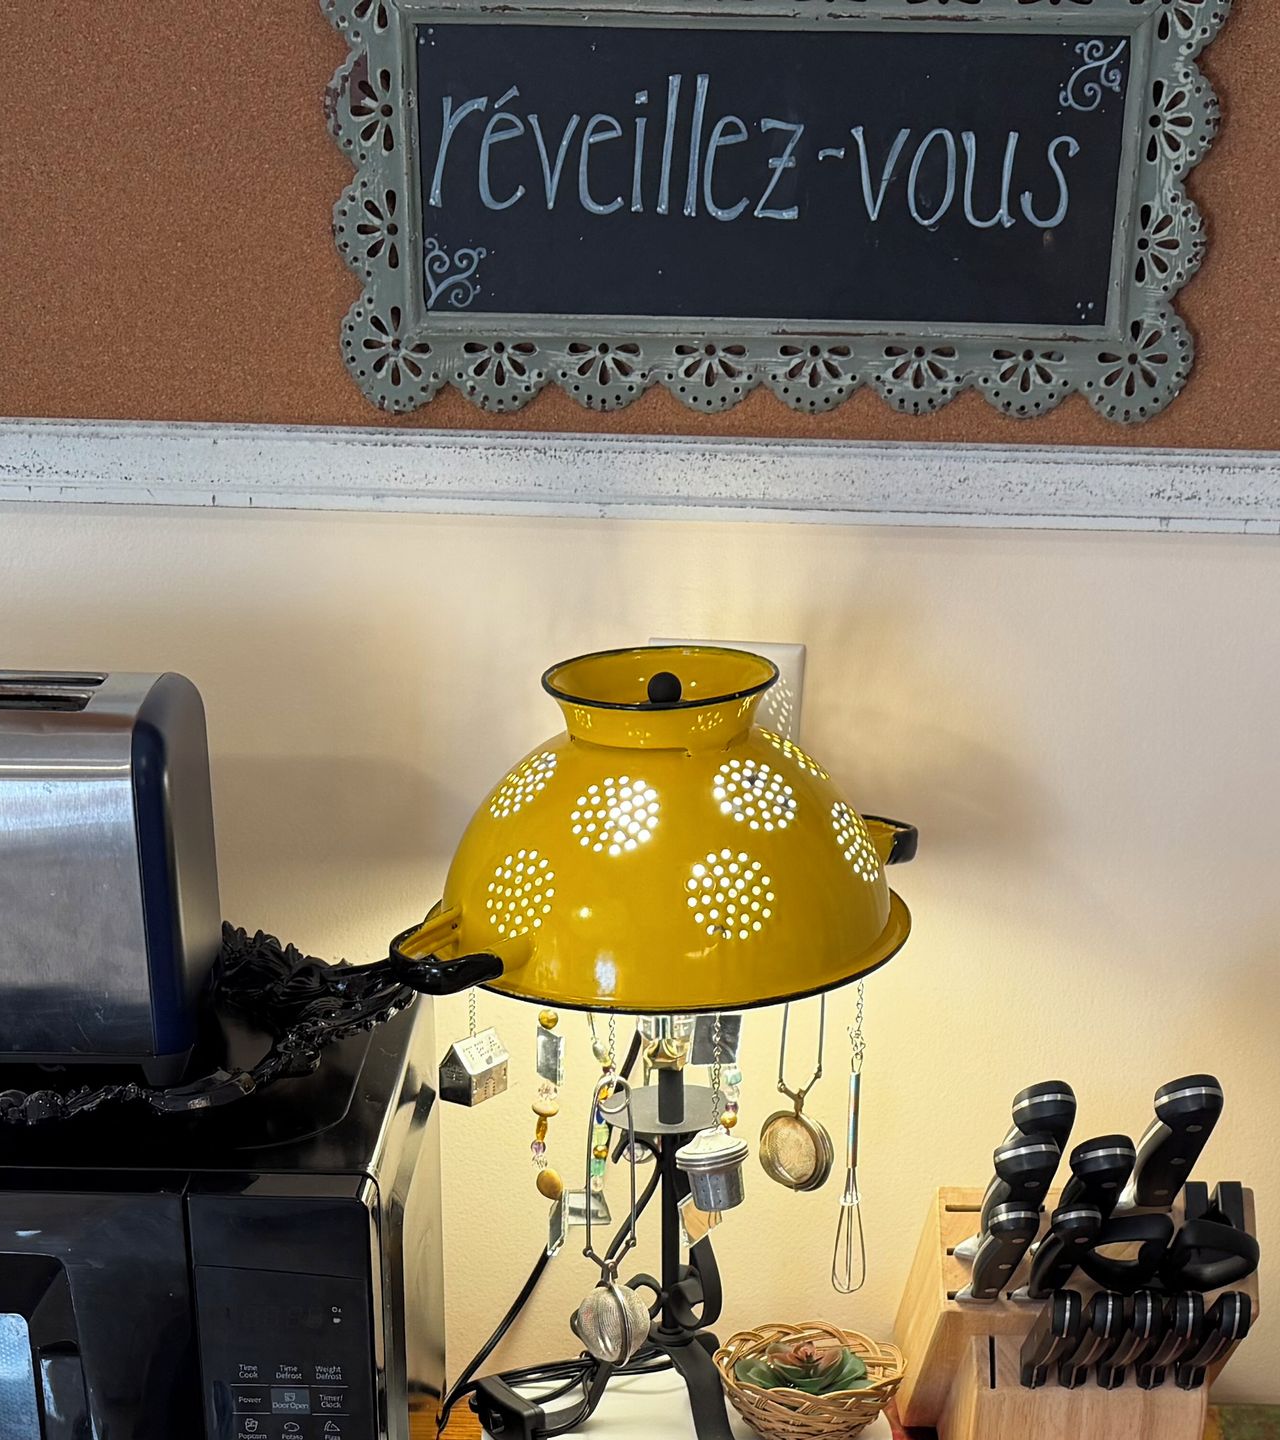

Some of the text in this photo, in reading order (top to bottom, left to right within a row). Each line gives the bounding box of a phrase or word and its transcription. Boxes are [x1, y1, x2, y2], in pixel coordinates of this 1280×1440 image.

[427, 72, 1081, 230] réveillez-vous
[280, 1364, 298, 1372] Time
[315, 1365, 342, 1374] Weight
[275, 1371, 302, 1379] Defrost
[315, 1372, 342, 1380] Defrost
[238, 1396, 262, 1404] Power
[290, 1402, 309, 1410] Open
[238, 1432, 267, 1440] Popcorn
